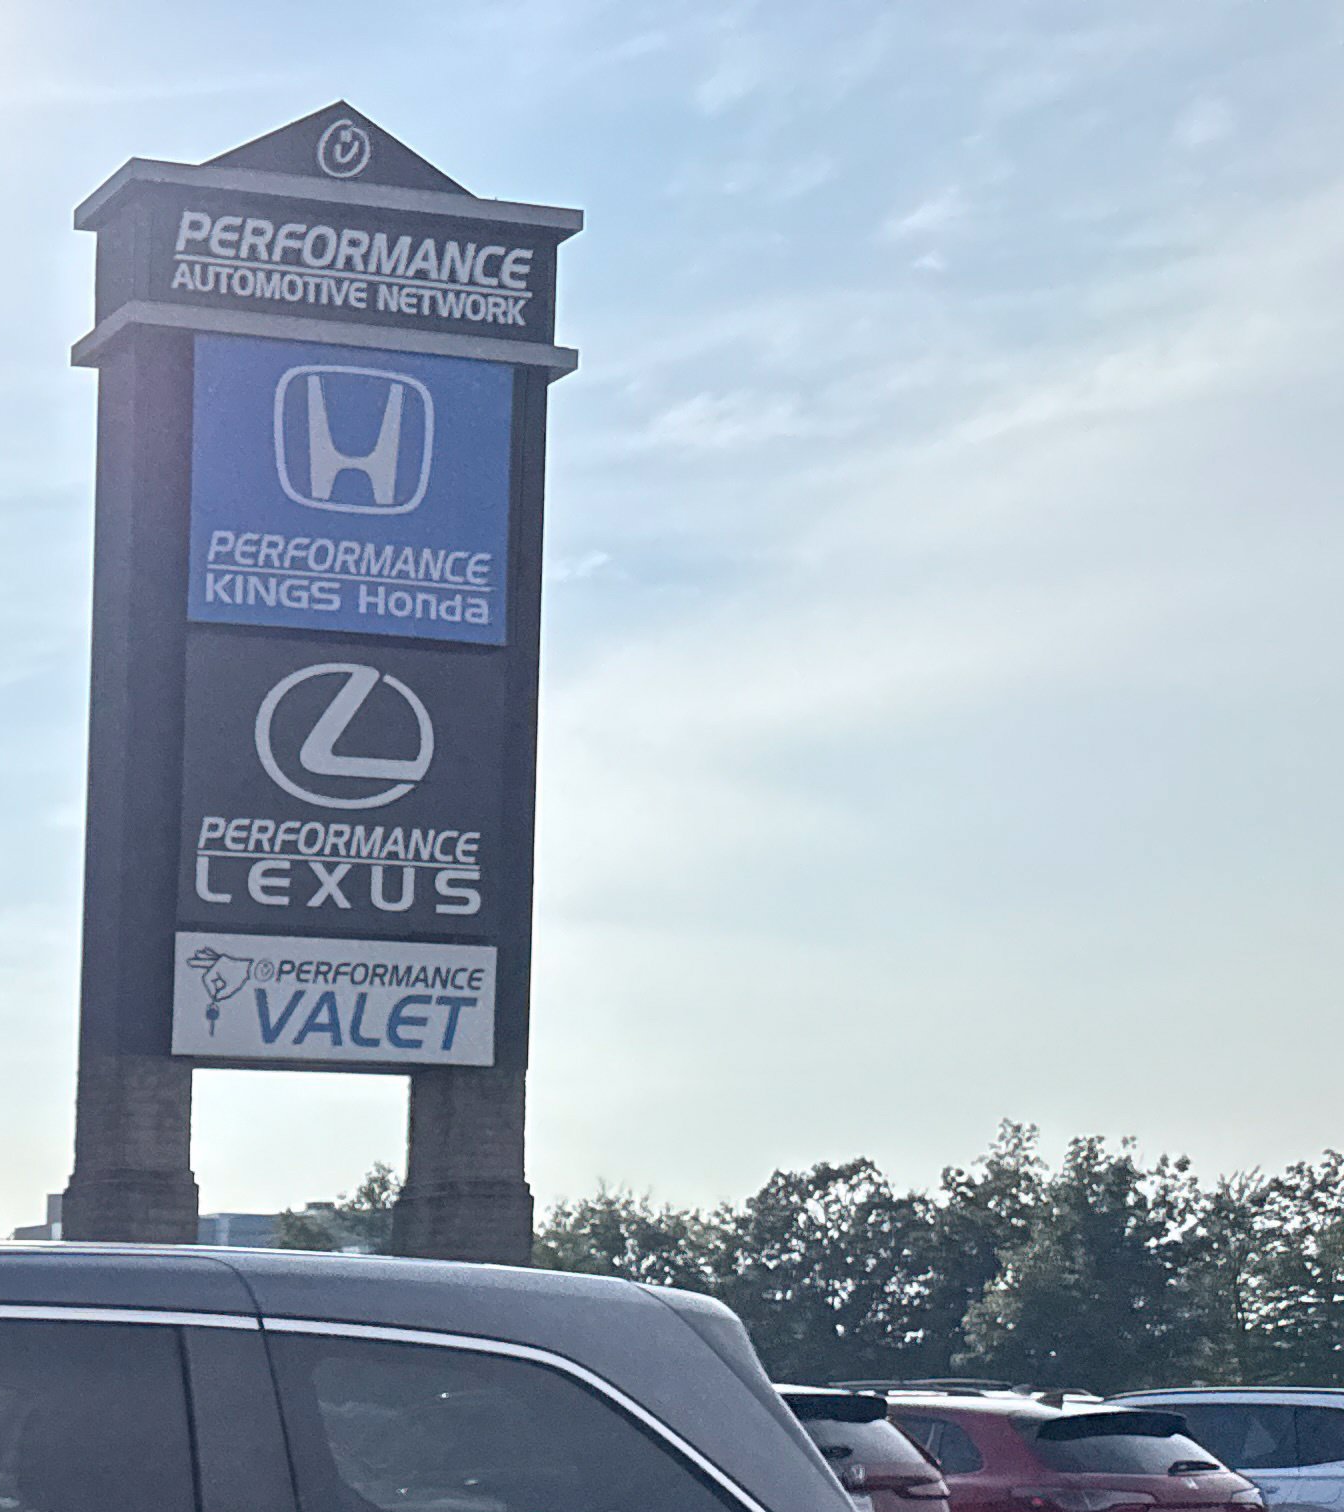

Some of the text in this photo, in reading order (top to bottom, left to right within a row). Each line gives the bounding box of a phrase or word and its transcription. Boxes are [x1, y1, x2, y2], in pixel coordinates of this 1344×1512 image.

[174, 209, 534, 290] PERFORMANCE
[171, 263, 527, 326] AUTOMOTIVE NETWORK
[207, 531, 492, 585] PERFORMANCE
[205, 572, 490, 625] KINGS Honda
[197, 816, 481, 865] PERFORMANCE
[195, 855, 482, 915] LEXUS
[275, 959, 485, 991] PERFORMANCE
[253, 988, 478, 1052] VALET
